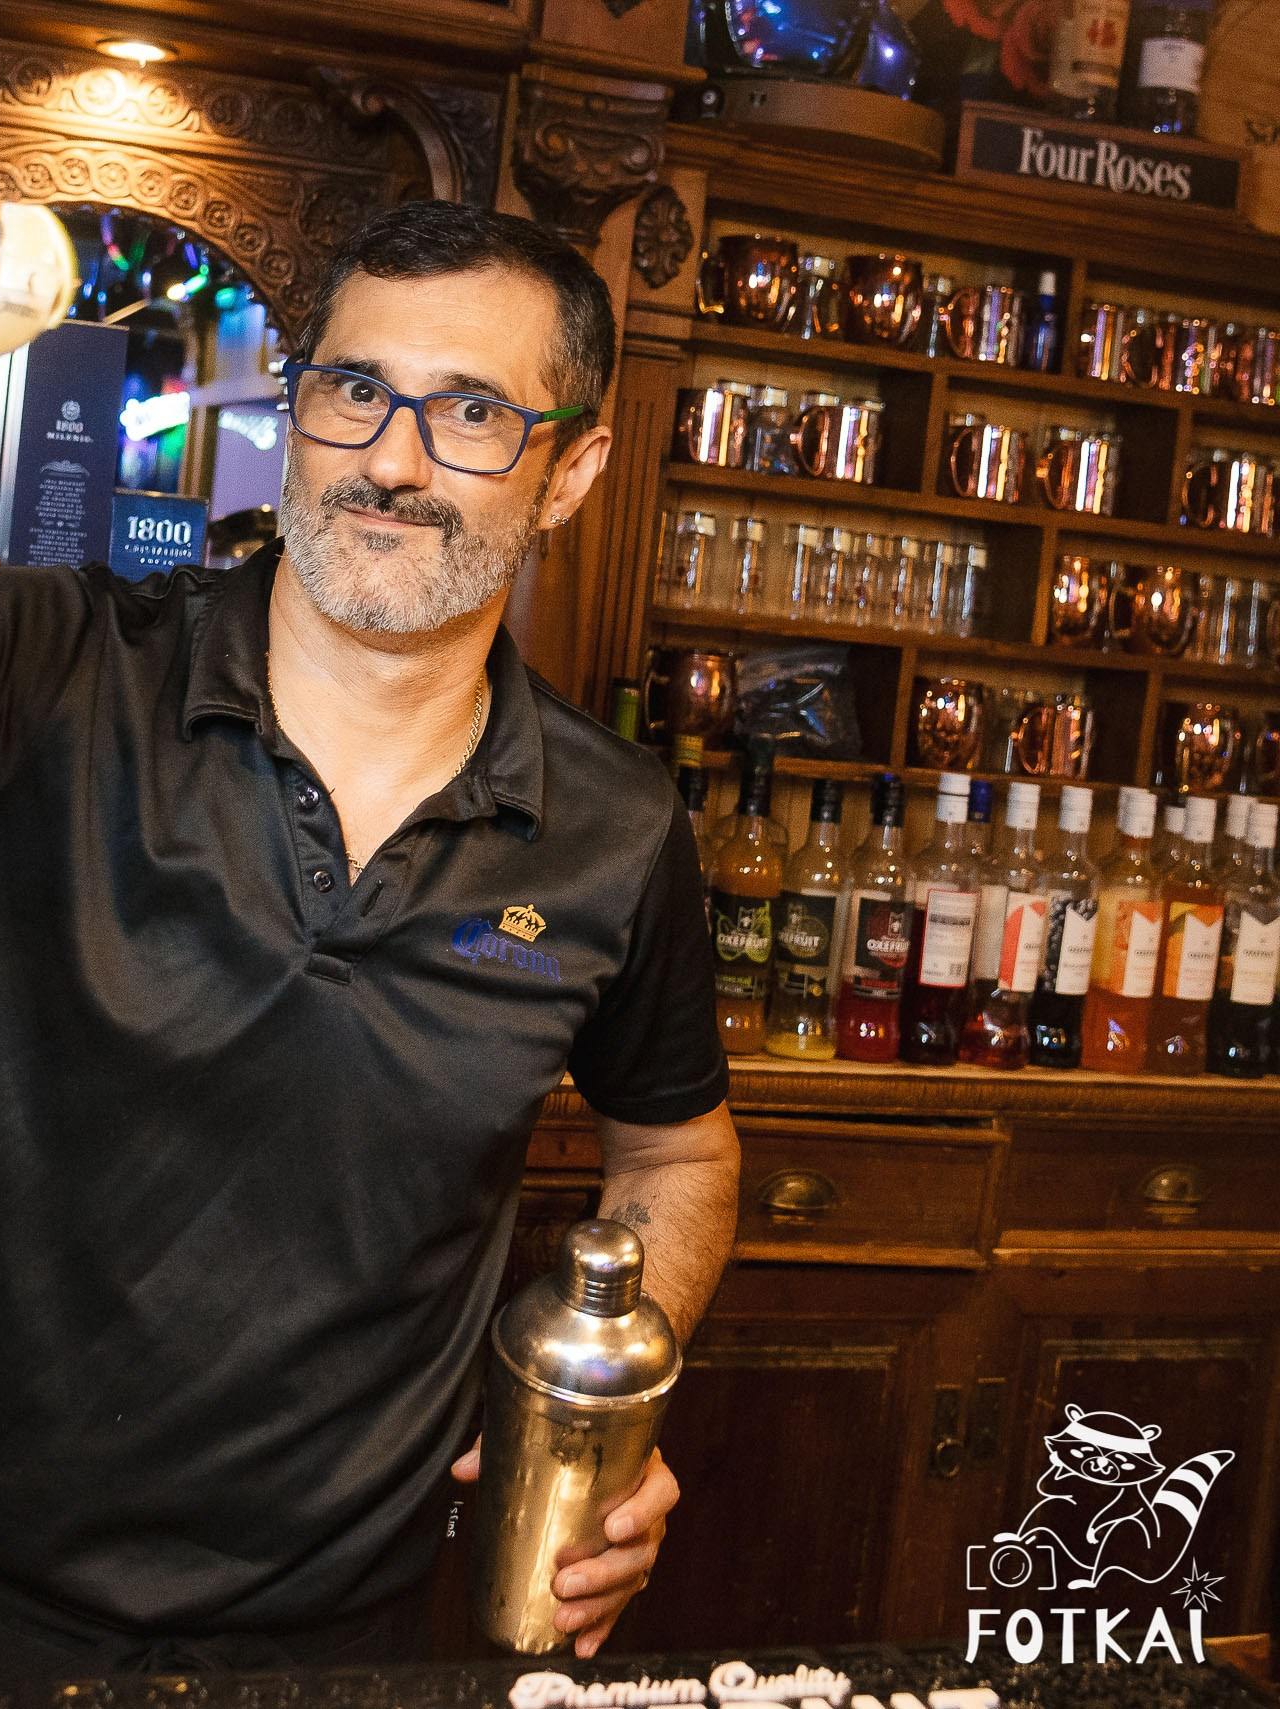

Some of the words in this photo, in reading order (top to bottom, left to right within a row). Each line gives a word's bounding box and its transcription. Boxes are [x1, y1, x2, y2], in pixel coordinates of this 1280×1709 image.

[1018, 126, 1095, 184] Four
[1093, 139, 1192, 201] Roses
[127, 515, 192, 545] 1800
[452, 918, 563, 985] Corona
[508, 1671, 707, 1709] Premium
[708, 1660, 851, 1706] Quality
